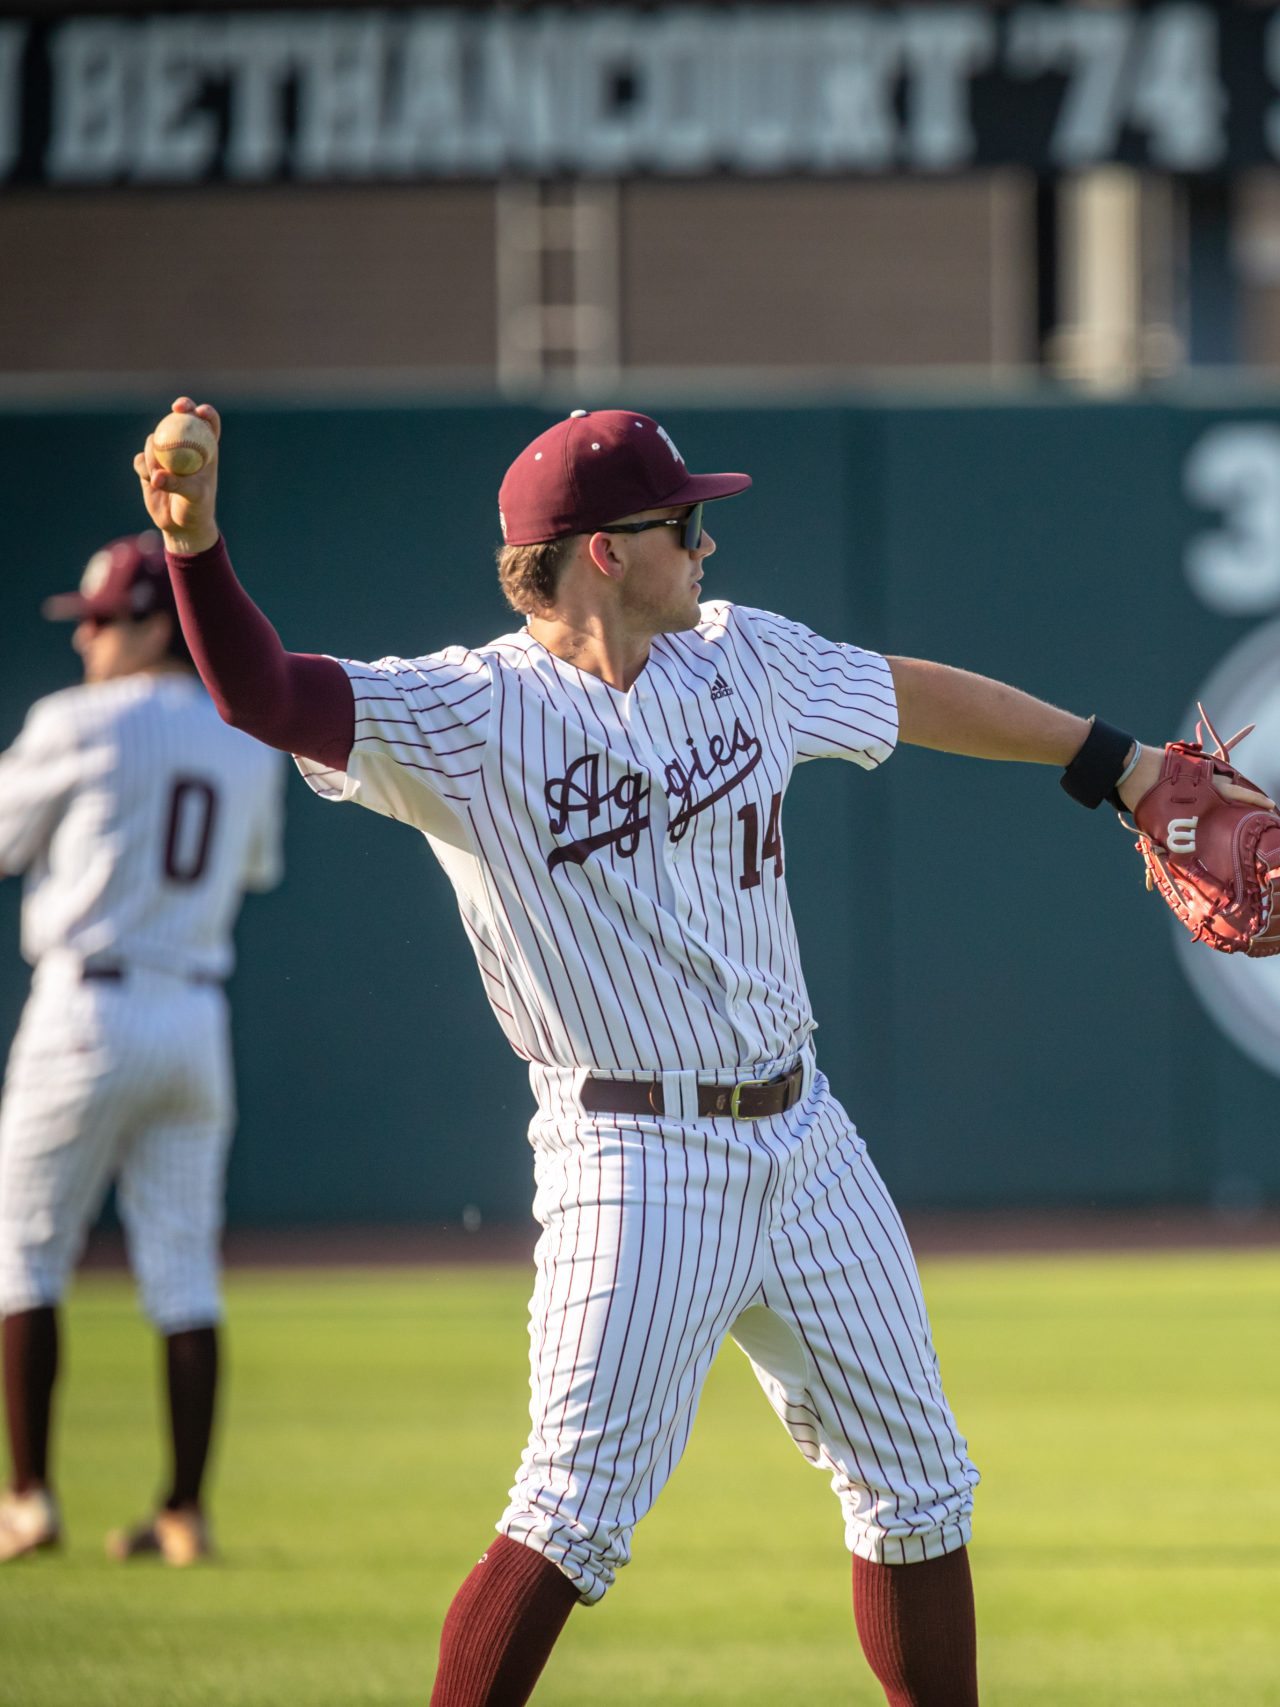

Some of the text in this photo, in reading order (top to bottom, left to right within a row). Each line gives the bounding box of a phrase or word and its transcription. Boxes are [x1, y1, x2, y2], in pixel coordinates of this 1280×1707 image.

[162, 776, 218, 885] 0
[544, 718, 762, 872] Aggies
[737, 792, 784, 890] 14
